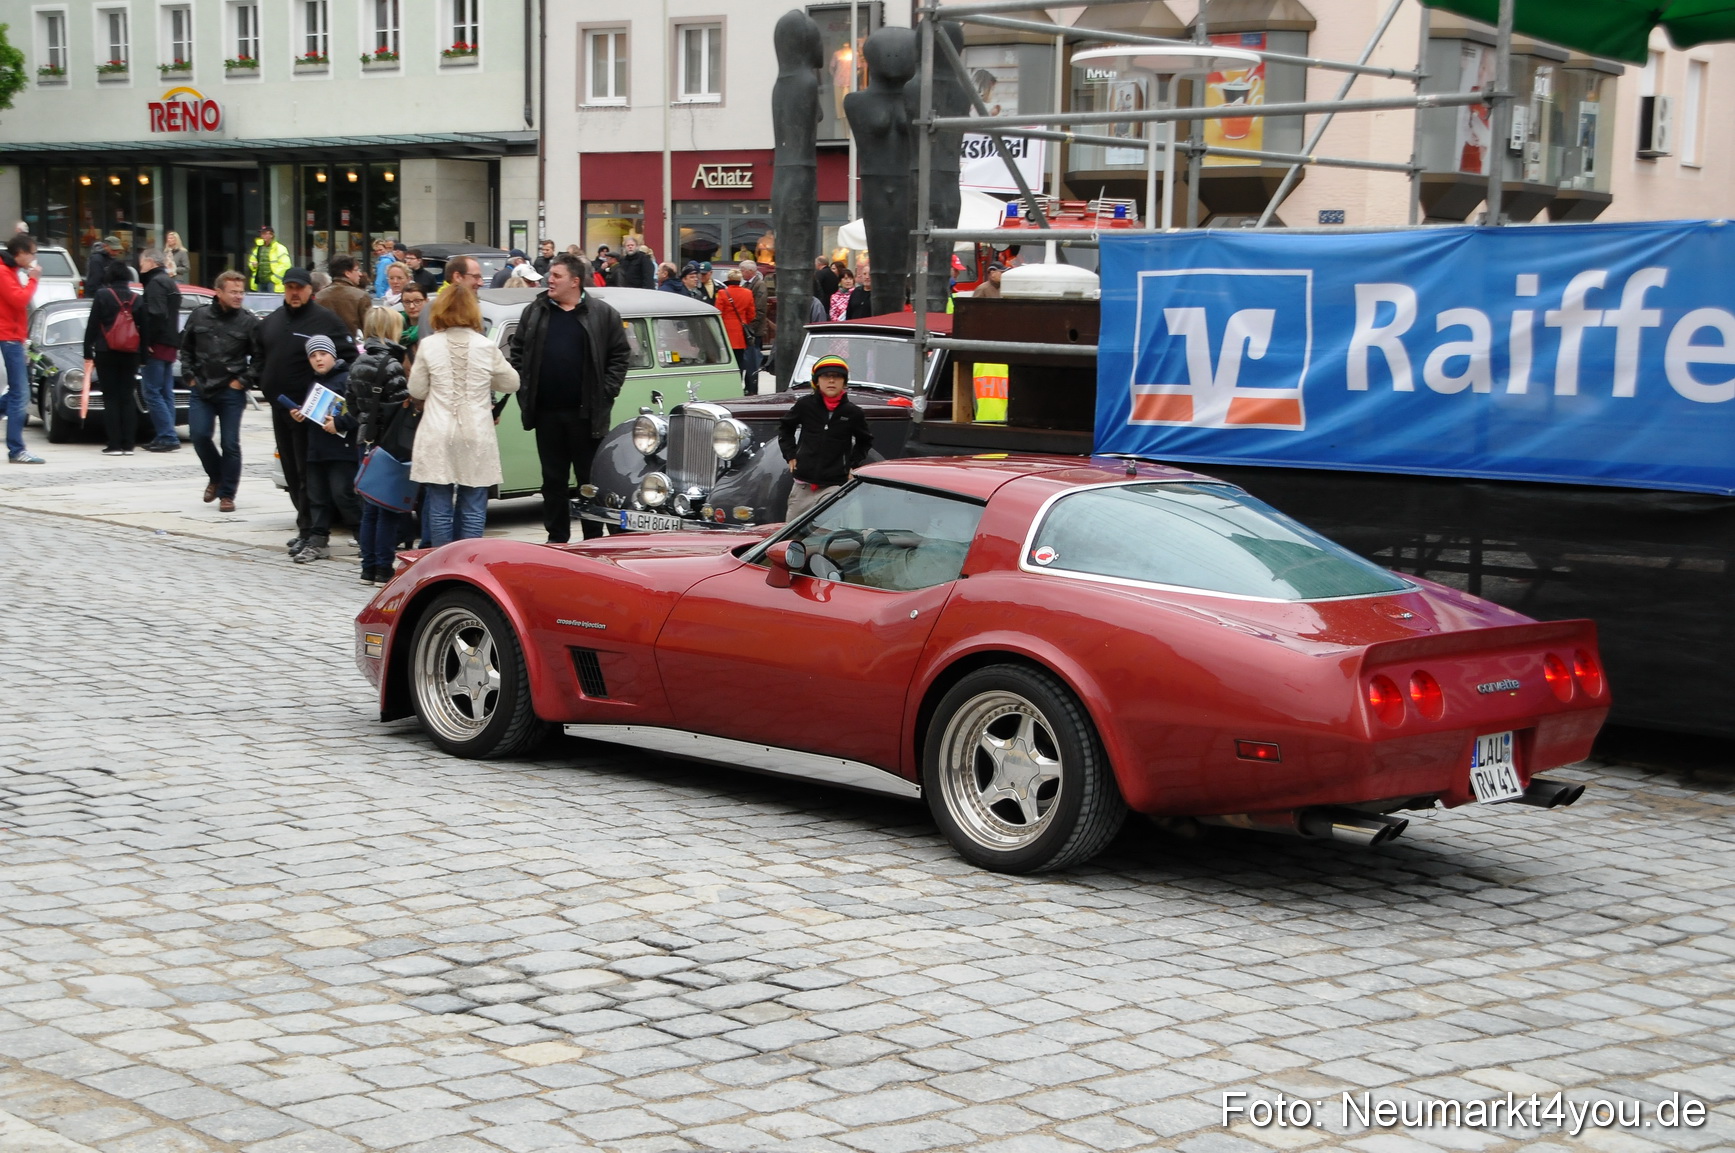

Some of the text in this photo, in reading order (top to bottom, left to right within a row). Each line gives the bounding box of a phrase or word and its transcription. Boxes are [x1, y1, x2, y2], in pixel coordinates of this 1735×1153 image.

[147, 99, 221, 133] RENO
[691, 163, 754, 188] Achatz
[1346, 266, 1735, 403] Raiffe
[637, 514, 651, 530] GH
[1477, 678, 1520, 694] corvette
[1478, 736, 1503, 768] LAU
[1497, 765, 1518, 795] 41
